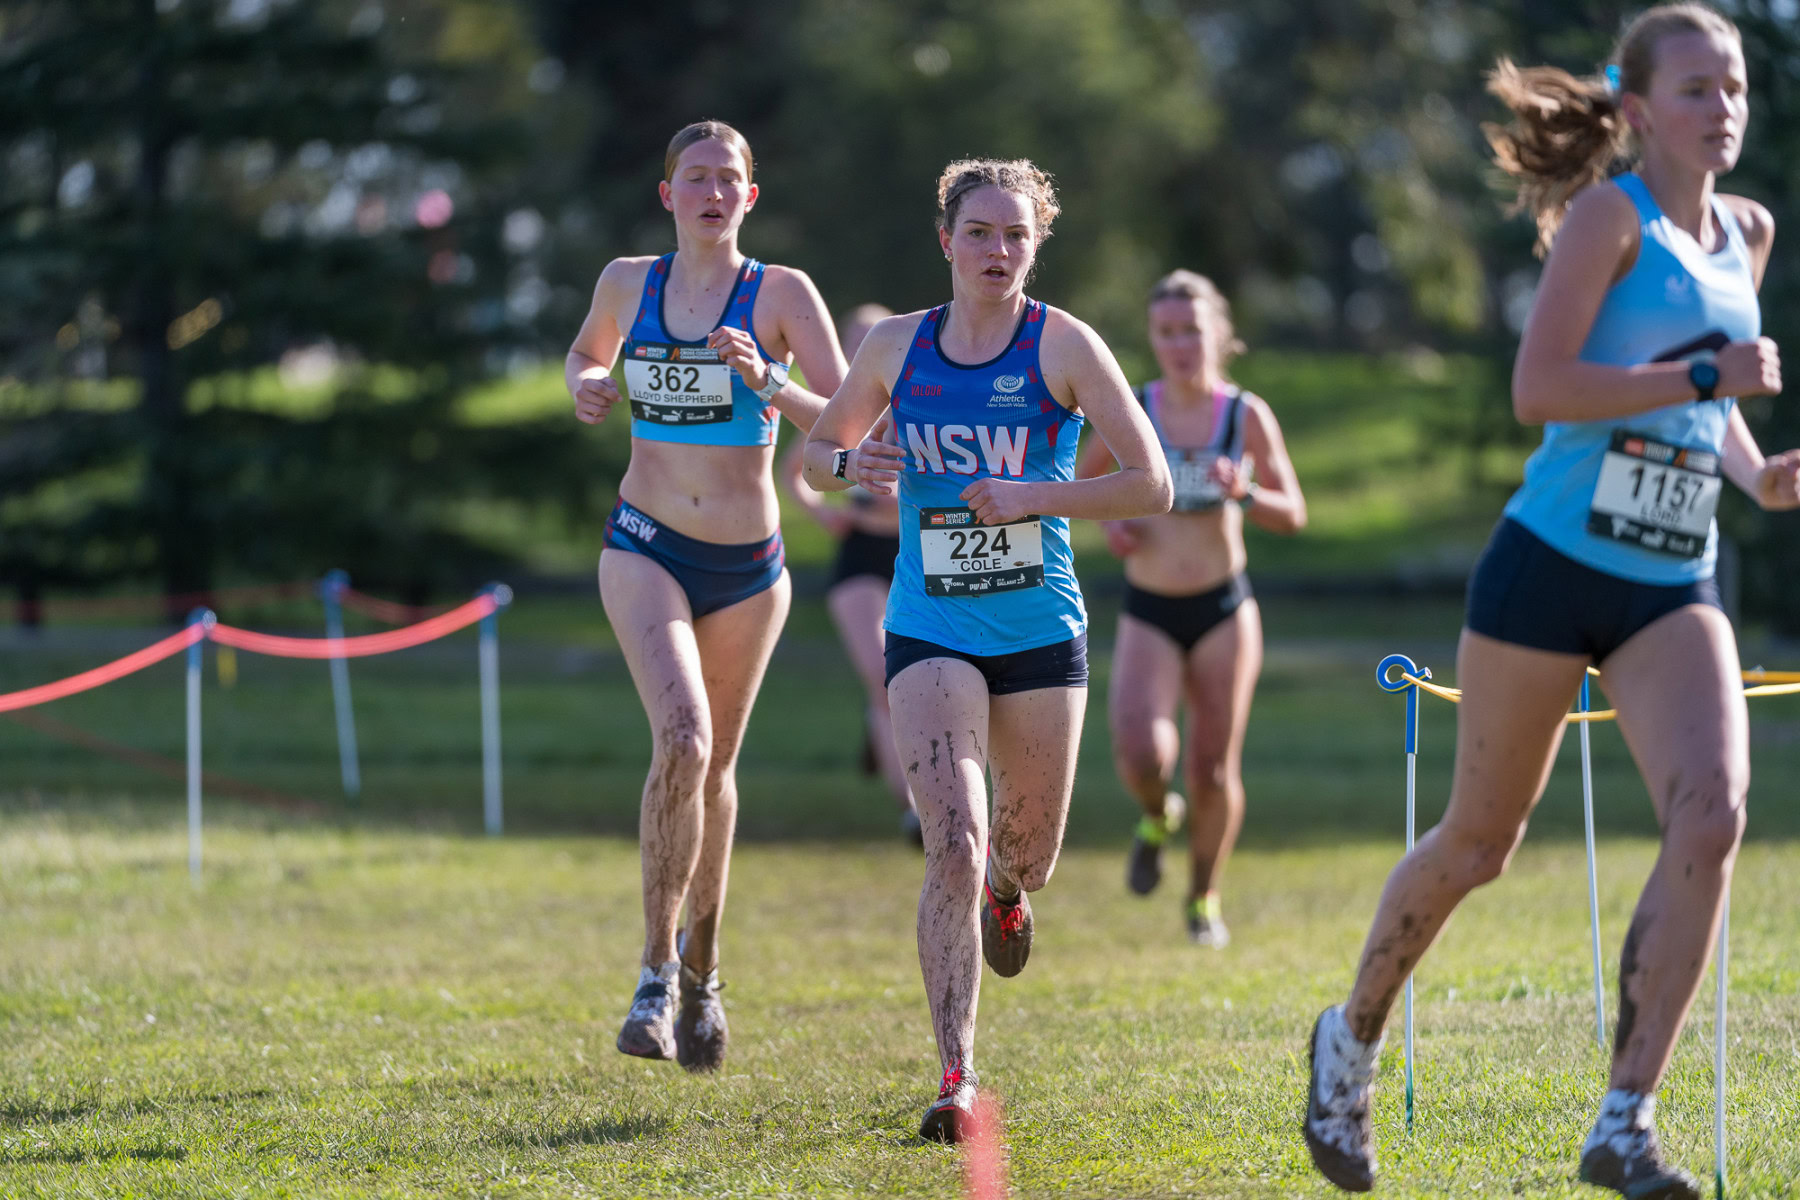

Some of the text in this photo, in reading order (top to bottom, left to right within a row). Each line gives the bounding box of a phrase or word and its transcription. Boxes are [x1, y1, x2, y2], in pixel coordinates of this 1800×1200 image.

[647, 364, 700, 392] 362
[633, 389, 723, 404] LLOYD SHEPHERD
[911, 385, 942, 397] VALOUR
[989, 394, 1025, 403] Athletics
[905, 422, 1031, 478] NSW
[1629, 465, 1704, 515] 1157
[944, 512, 970, 520] WINTER
[616, 509, 658, 543] NSW
[949, 527, 1011, 560] 224
[960, 558, 1002, 573] COLE
[969, 583, 988, 591] PUMA
